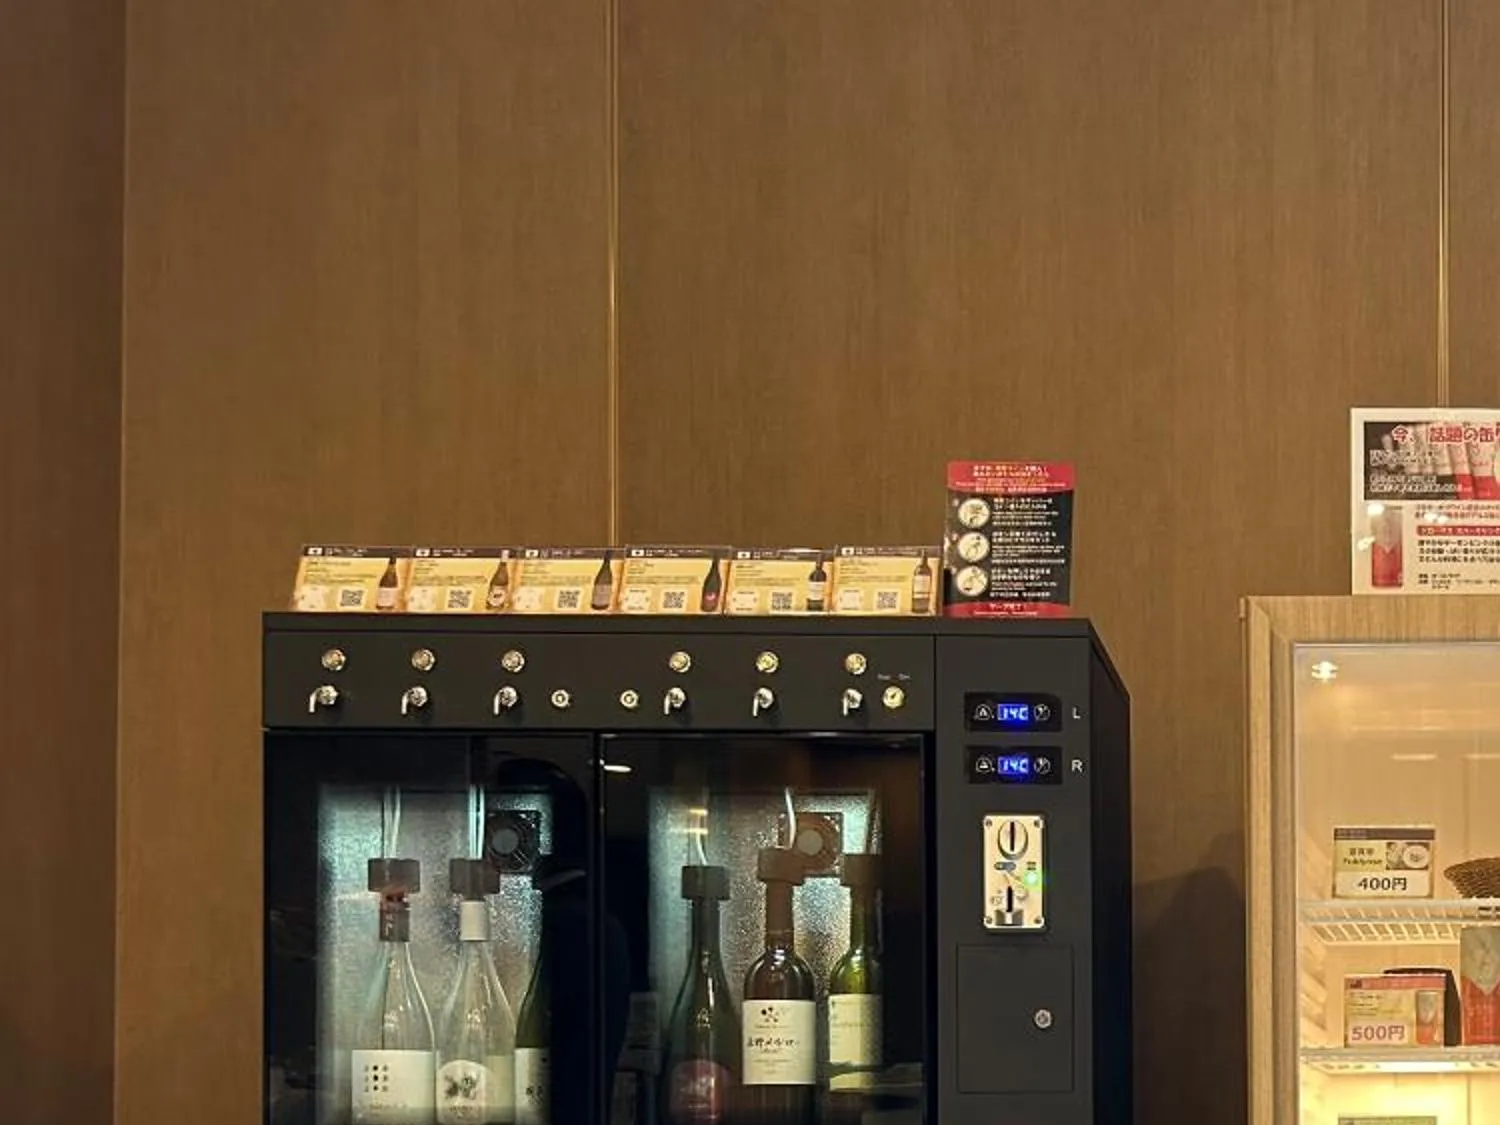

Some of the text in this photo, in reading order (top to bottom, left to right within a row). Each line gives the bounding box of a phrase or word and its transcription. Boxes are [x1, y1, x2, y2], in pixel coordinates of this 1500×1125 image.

[1071, 706, 1081, 719] L
[1070, 759, 1083, 773] R
[1357, 876, 1407, 891] 400円
[1351, 1024, 1405, 1041] 500円
